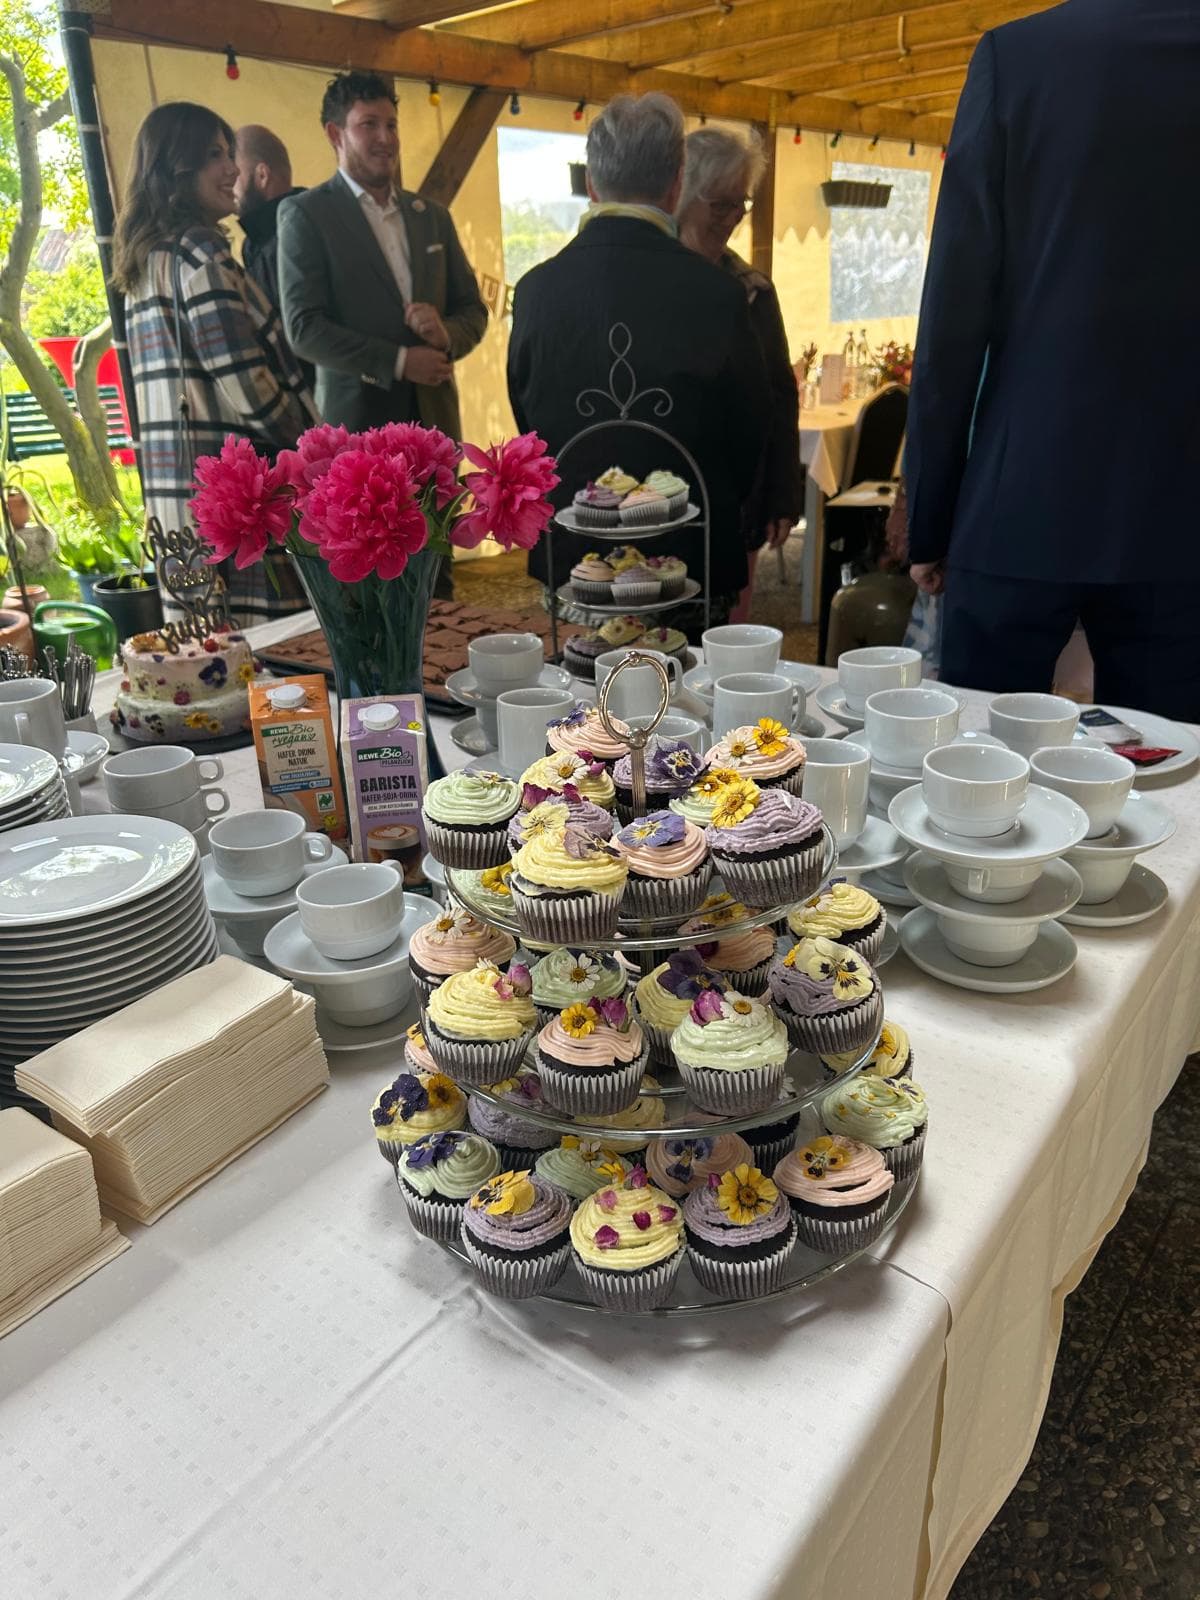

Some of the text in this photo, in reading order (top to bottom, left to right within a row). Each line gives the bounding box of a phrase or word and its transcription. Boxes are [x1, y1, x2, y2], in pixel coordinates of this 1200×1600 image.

[270, 723, 314, 736] REWE Bio
[278, 748, 316, 759] HAFER DRINK
[358, 747, 402, 761] REWE Bio
[288, 757, 308, 766] NATUR
[360, 775, 417, 793] BARISTA
[361, 791, 418, 803] HAFER-SOJA-DRINK
